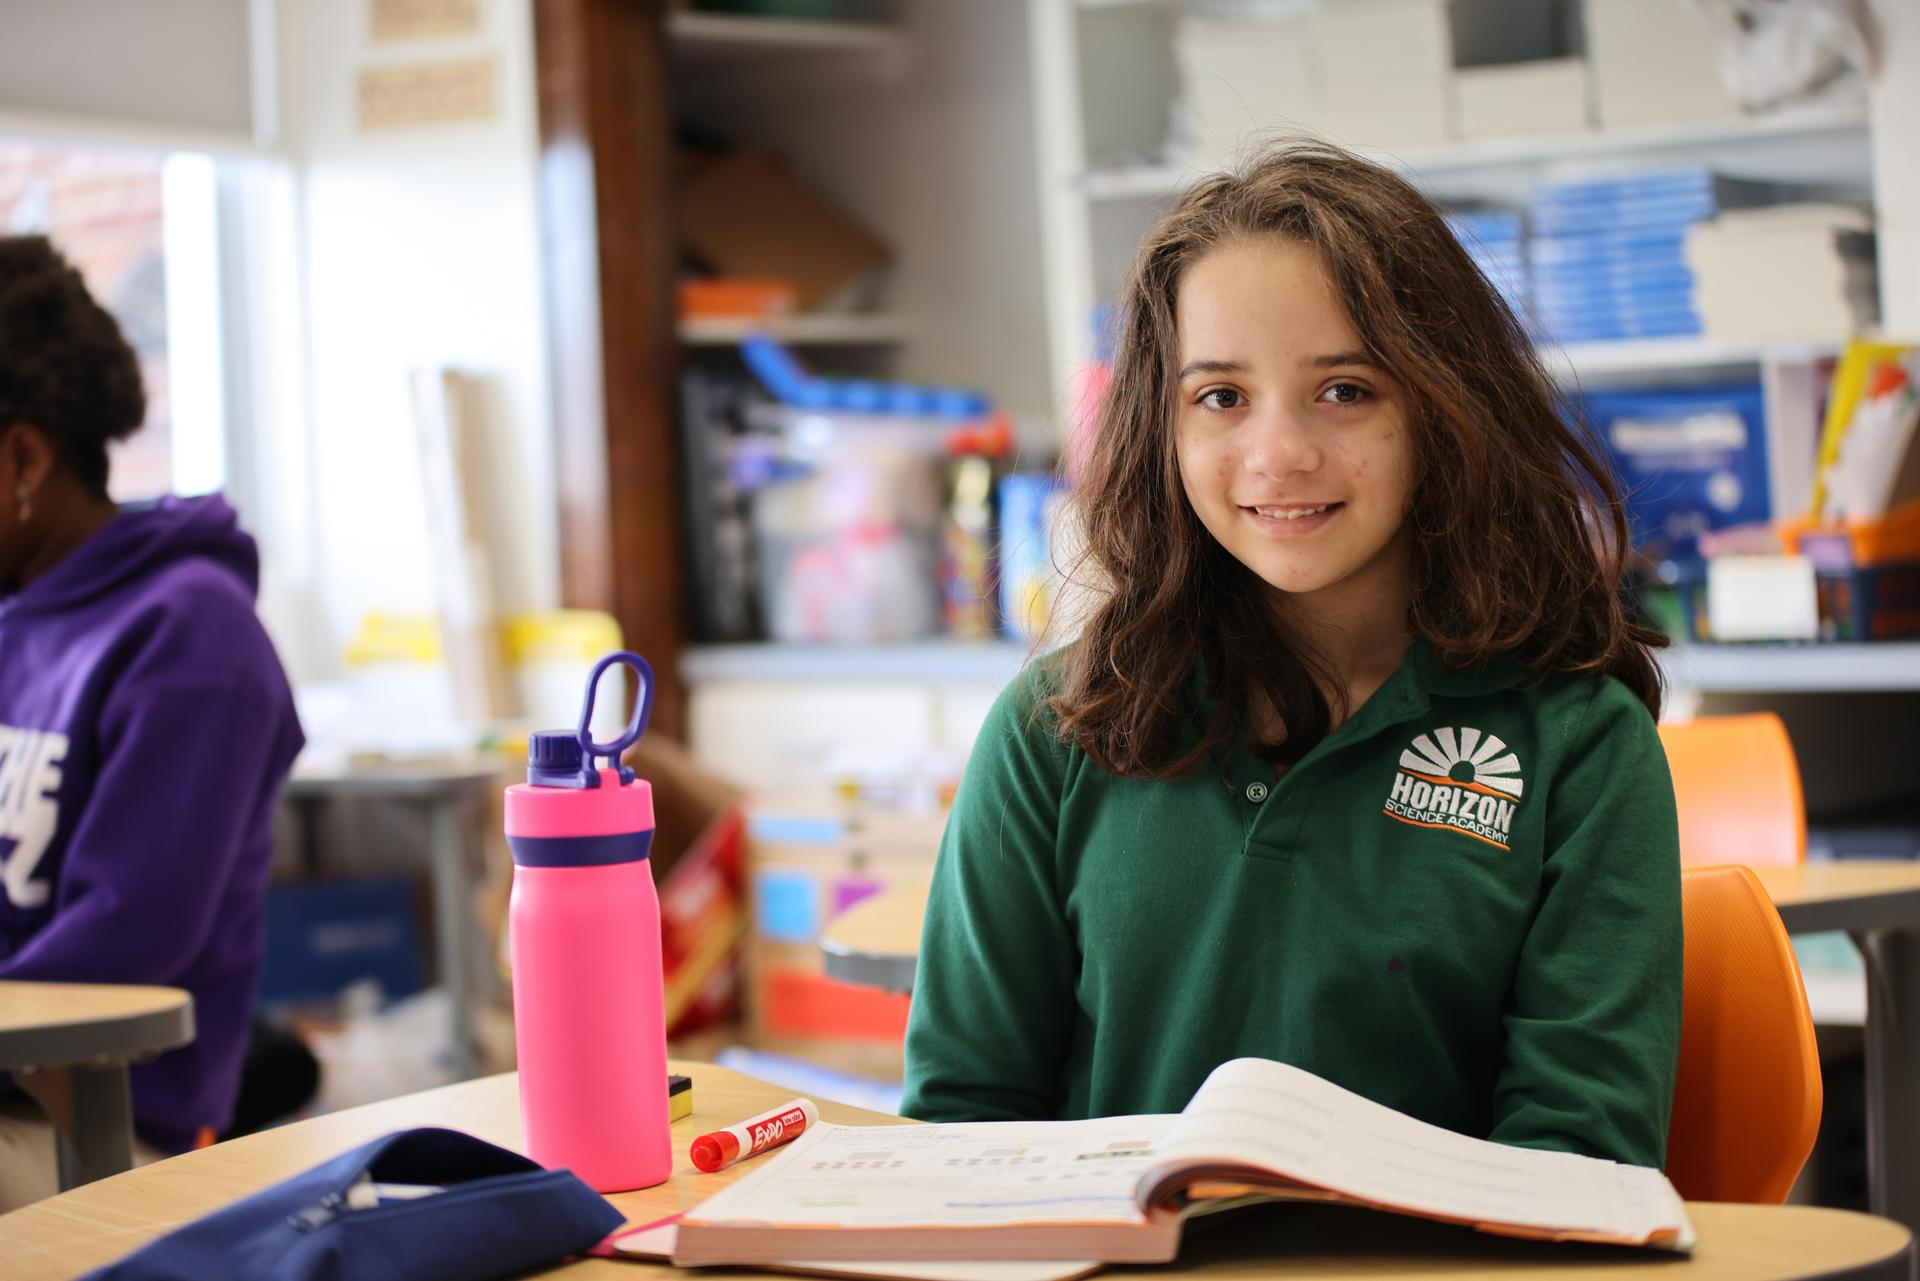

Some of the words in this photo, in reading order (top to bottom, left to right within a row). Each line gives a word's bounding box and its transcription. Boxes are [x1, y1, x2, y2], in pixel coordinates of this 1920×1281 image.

[1384, 798, 1447, 824] SCIENCE
[1446, 815, 1509, 844] ACADEMY
[1390, 772, 1517, 833] HORIZON
[753, 1119, 784, 1150] EXPO
